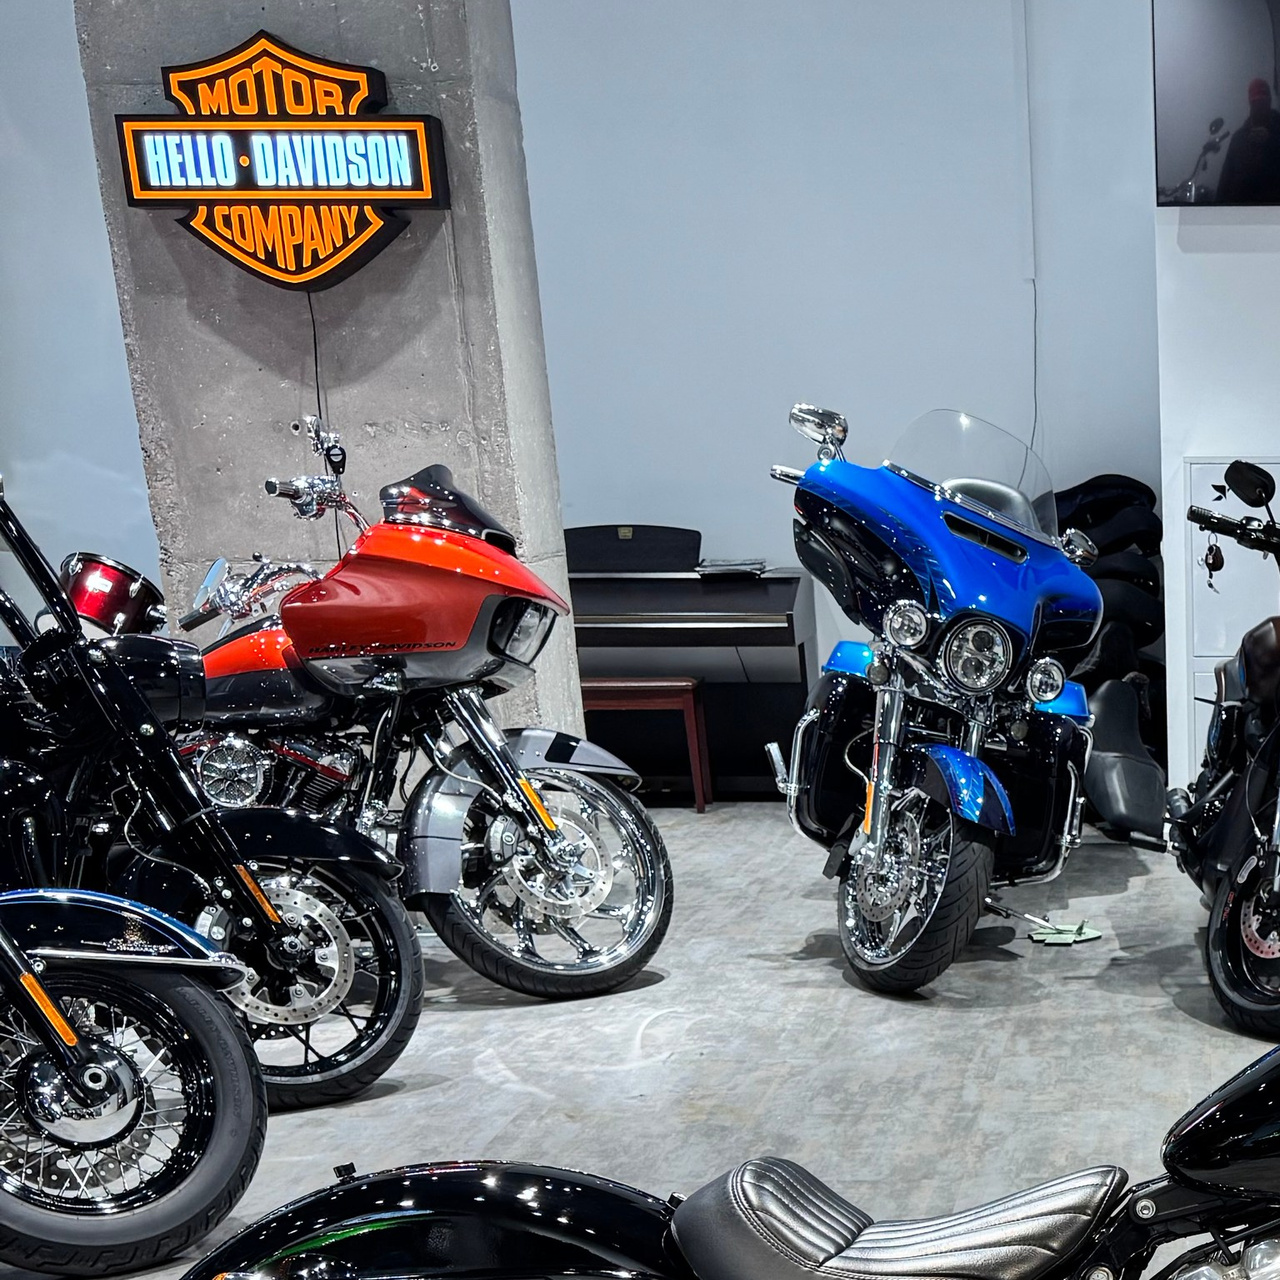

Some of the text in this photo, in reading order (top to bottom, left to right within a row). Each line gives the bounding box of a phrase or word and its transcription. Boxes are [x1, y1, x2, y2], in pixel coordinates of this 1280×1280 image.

[197, 56, 345, 115] MOTOR
[143, 134, 412, 187] HELLO DAVIDSON
[213, 205, 359, 271] COMPANY
